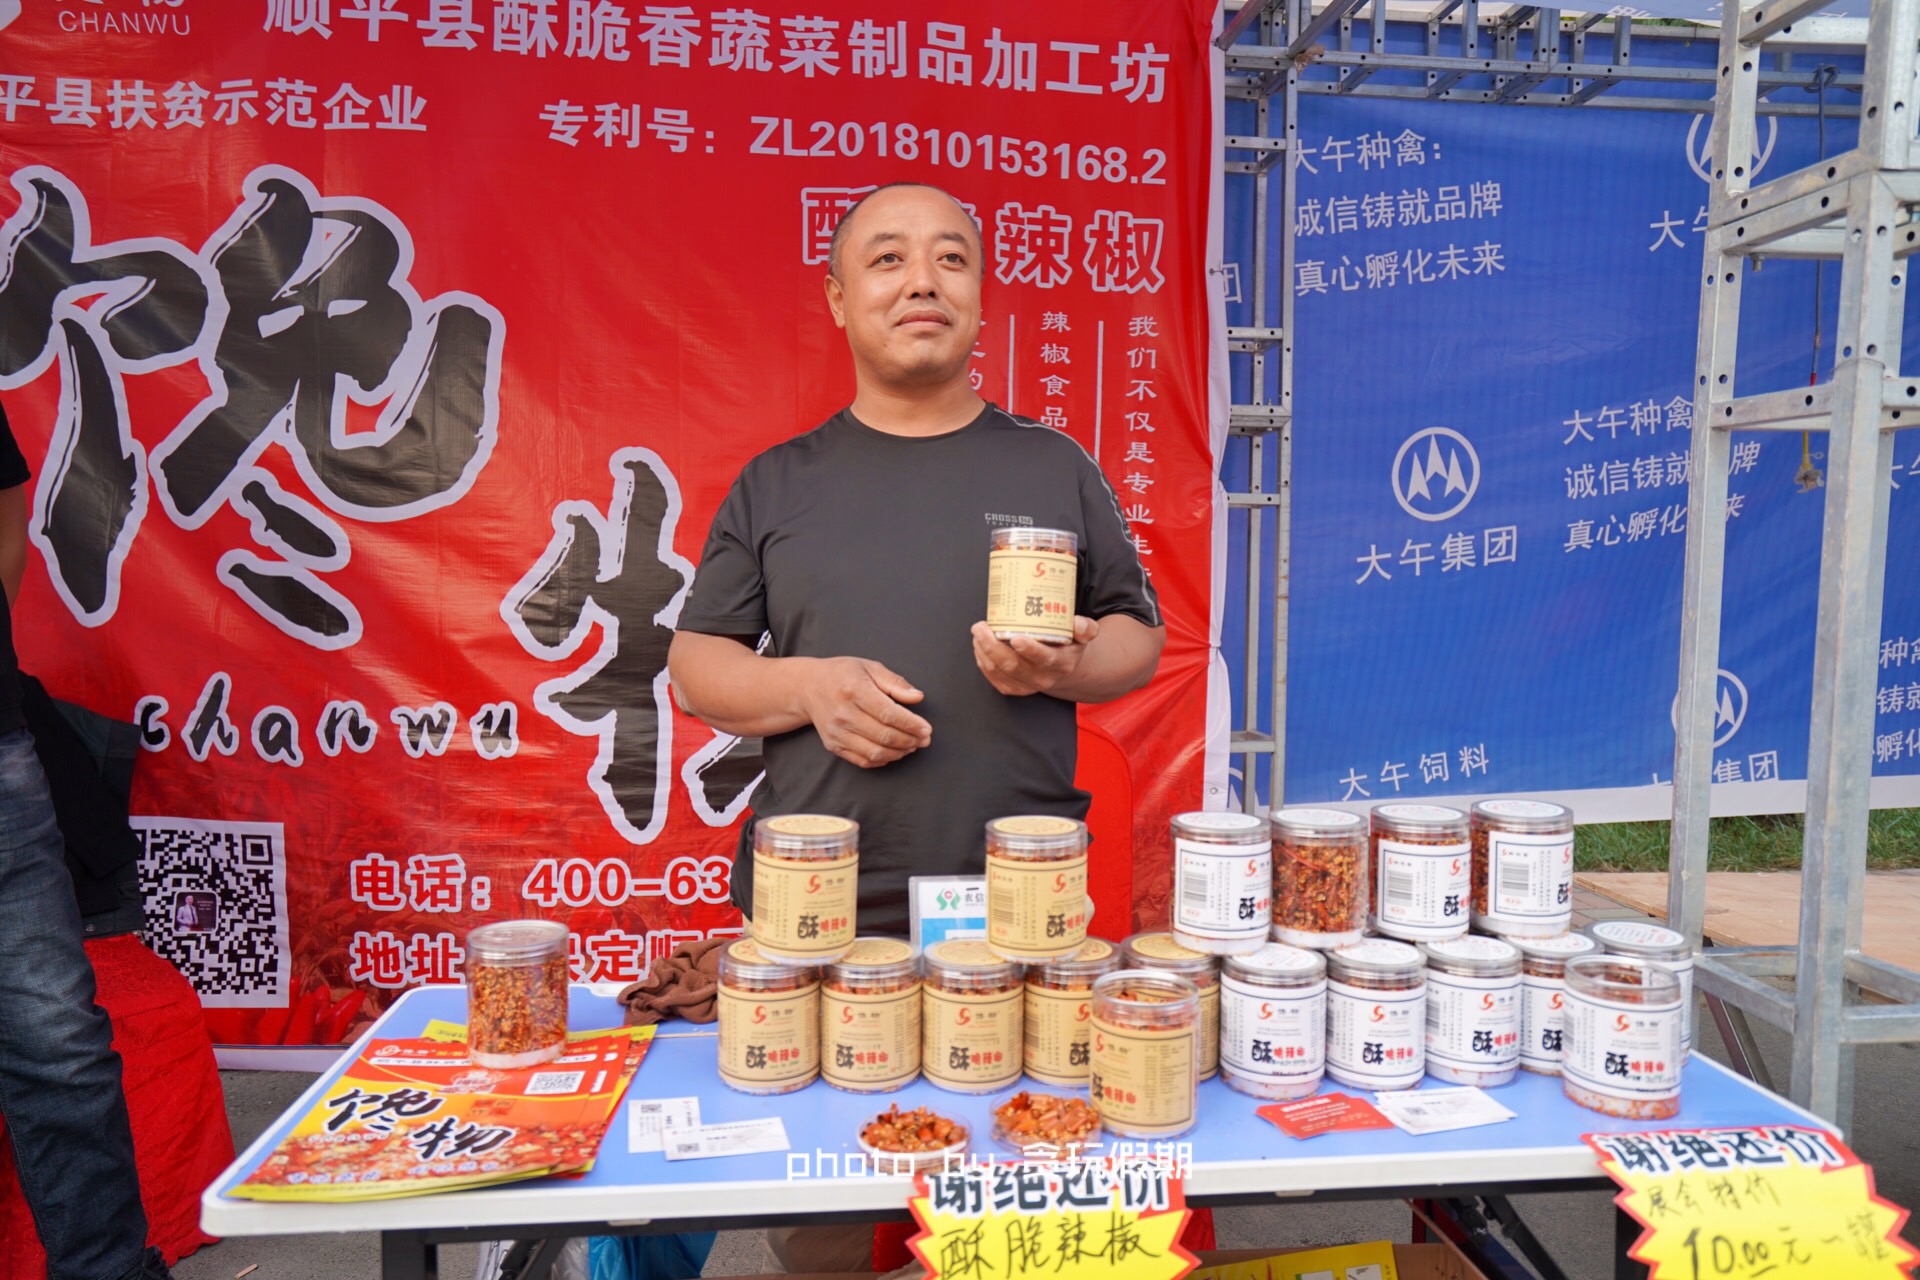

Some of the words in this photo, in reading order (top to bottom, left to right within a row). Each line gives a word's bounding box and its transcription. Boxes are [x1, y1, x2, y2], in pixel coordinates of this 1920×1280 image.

[58, 10, 190, 36] CHANWU
[262, 0, 1170, 104] 顺平县酥脆香蔬菜制品加工坊
[0, 74, 428, 133] 平县扶贫示范企业
[749, 116, 1168, 186] ZL201810153168.2
[1295, 240, 1506, 296] 真心孵化未来
[1038, 311, 1072, 428] 辣椒食品
[1122, 315, 1160, 577] 我们不仅是专业生
[1563, 440, 1761, 500] 诚信铸就牌
[1355, 524, 1519, 585] 大午集团
[134, 672, 519, 767] chanwu
[1338, 742, 1490, 801] 大午饲料
[350, 853, 491, 912] 电话：
[1598, 1129, 1842, 1173] 谢绝还价
